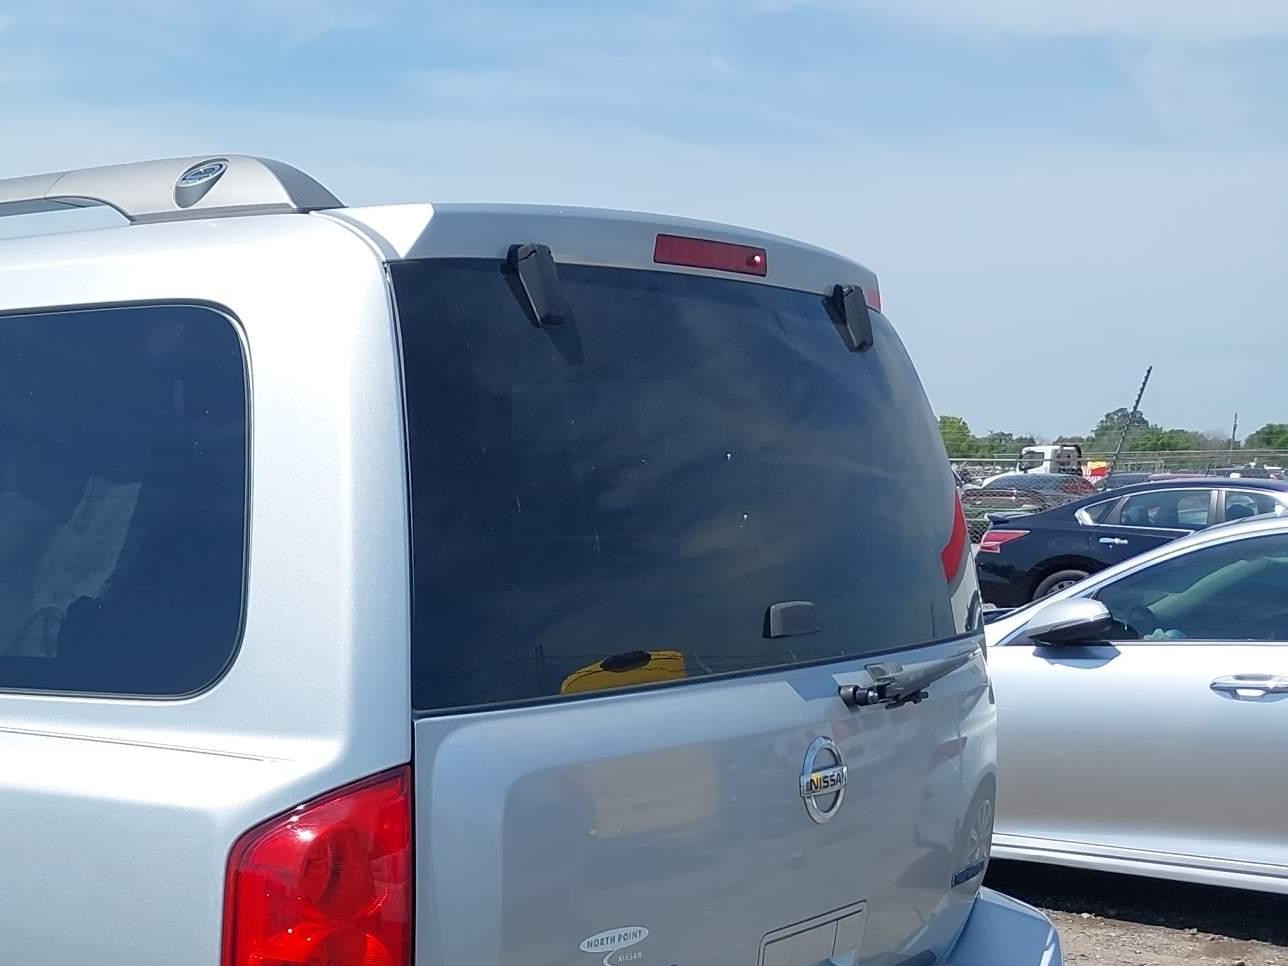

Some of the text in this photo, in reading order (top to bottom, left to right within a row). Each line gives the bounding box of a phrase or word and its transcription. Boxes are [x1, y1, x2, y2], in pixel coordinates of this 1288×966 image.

[585, 929, 643, 949] NORTH POINT
[617, 951, 643, 964] NISSAN
